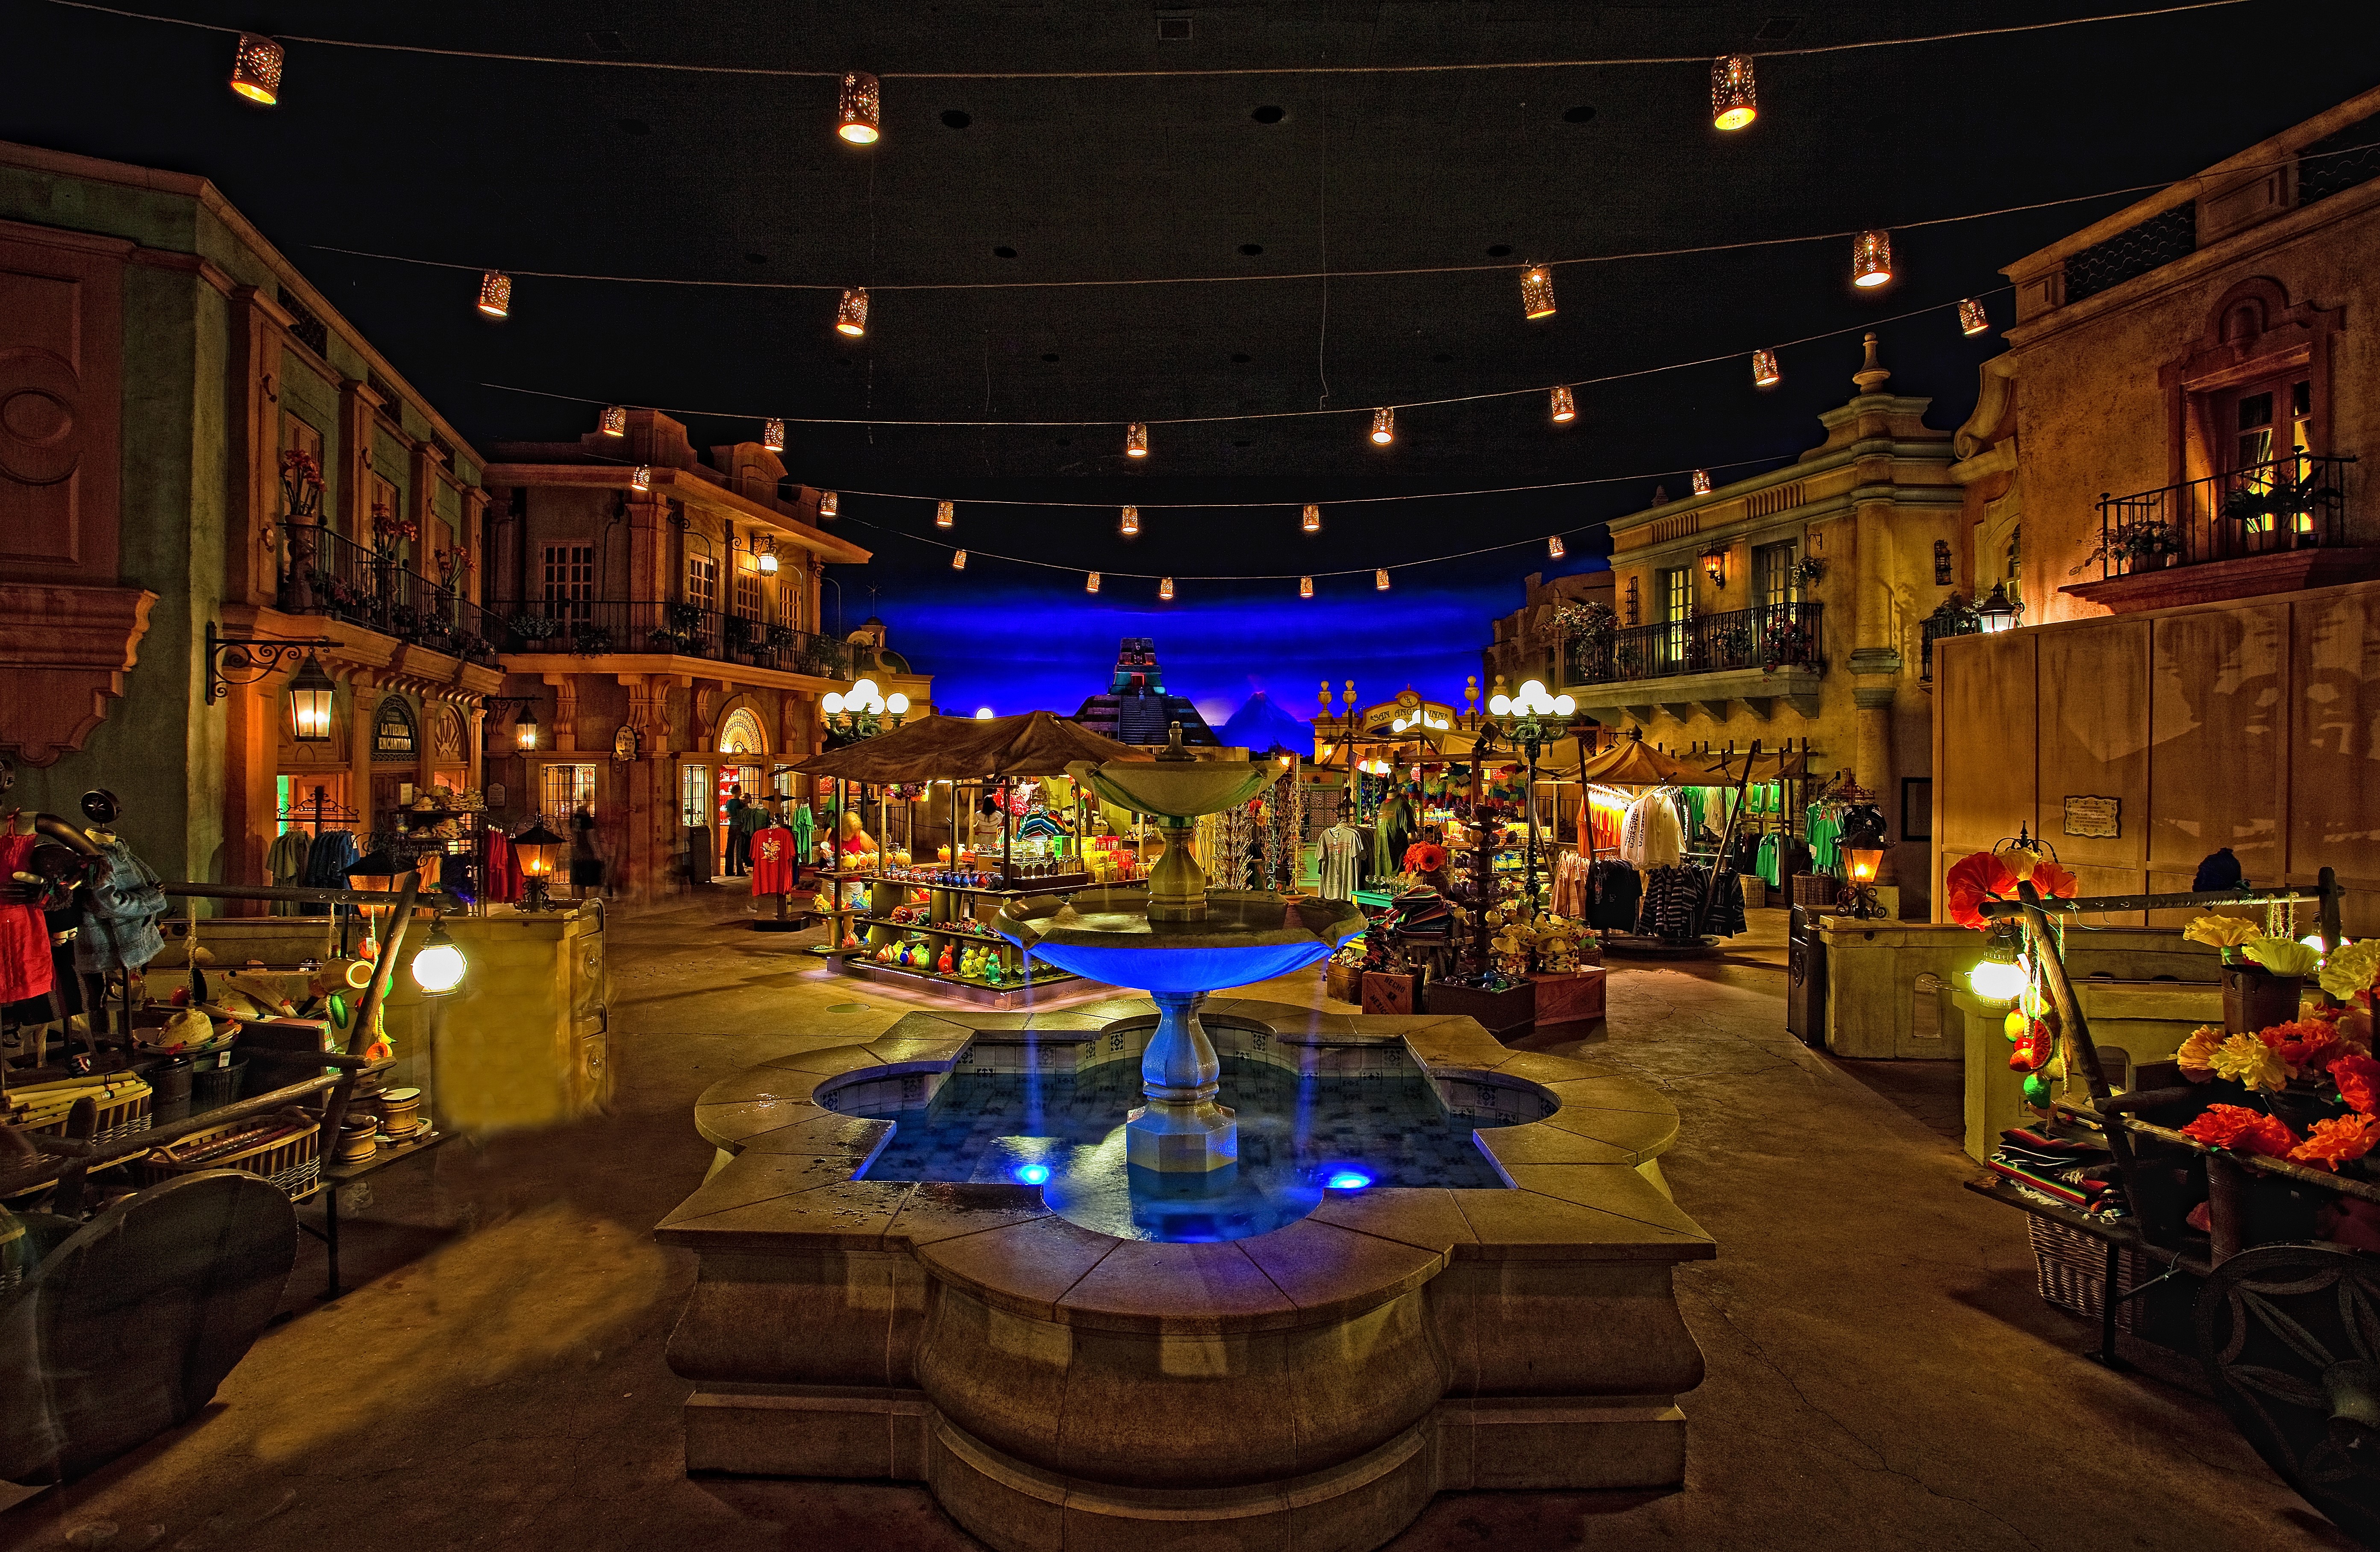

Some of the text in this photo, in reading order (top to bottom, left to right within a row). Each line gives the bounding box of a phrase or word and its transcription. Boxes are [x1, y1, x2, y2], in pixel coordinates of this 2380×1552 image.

[1370, 708, 1448, 722] SAN ANG INN
[381, 723, 409, 737] LA TIENDA
[378, 737, 411, 750] ENCANTADA
[1384, 976, 1405, 993] HECHO
